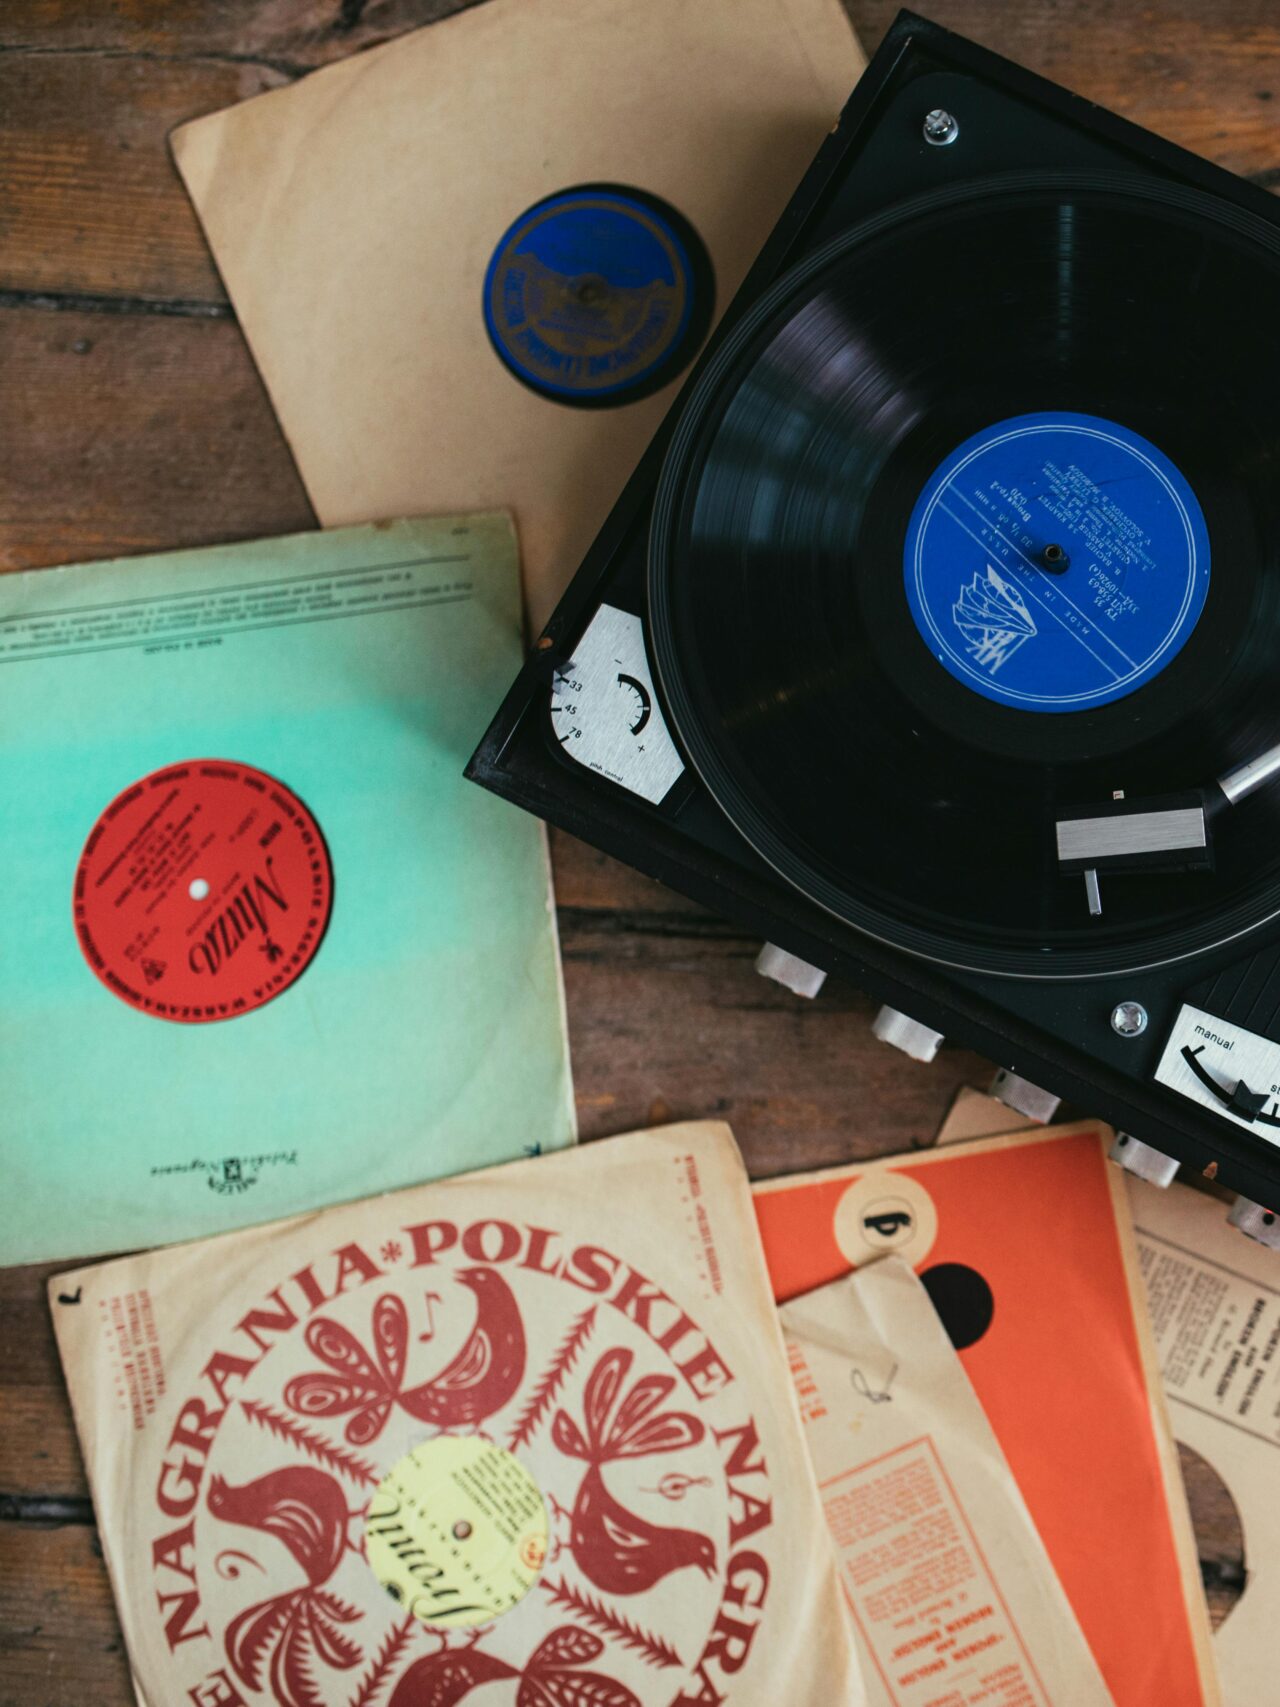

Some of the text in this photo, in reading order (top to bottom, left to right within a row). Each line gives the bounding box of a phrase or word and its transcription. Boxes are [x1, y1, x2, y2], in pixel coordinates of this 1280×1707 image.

[1079, 523, 1103, 548] BASNER
[1017, 564, 1035, 581] THE
[1042, 588, 1056, 602] IN
[1092, 594, 1105, 608] 35
[1065, 610, 1089, 634] MADE
[568, 680, 583, 692] 33
[564, 704, 578, 715] 45
[568, 726, 583, 739] 78
[604, 768, 624, 782] control
[292, 816, 321, 907] POLSKIE
[188, 856, 289, 975] Muza
[251, 917, 319, 1000] NAGRANIA
[145, 997, 244, 1017] WARSZAWA
[1193, 1023, 1236, 1052] manual
[150, 1241, 387, 1655] NAGRANIA
[406, 1219, 736, 1402] POLSKIE
